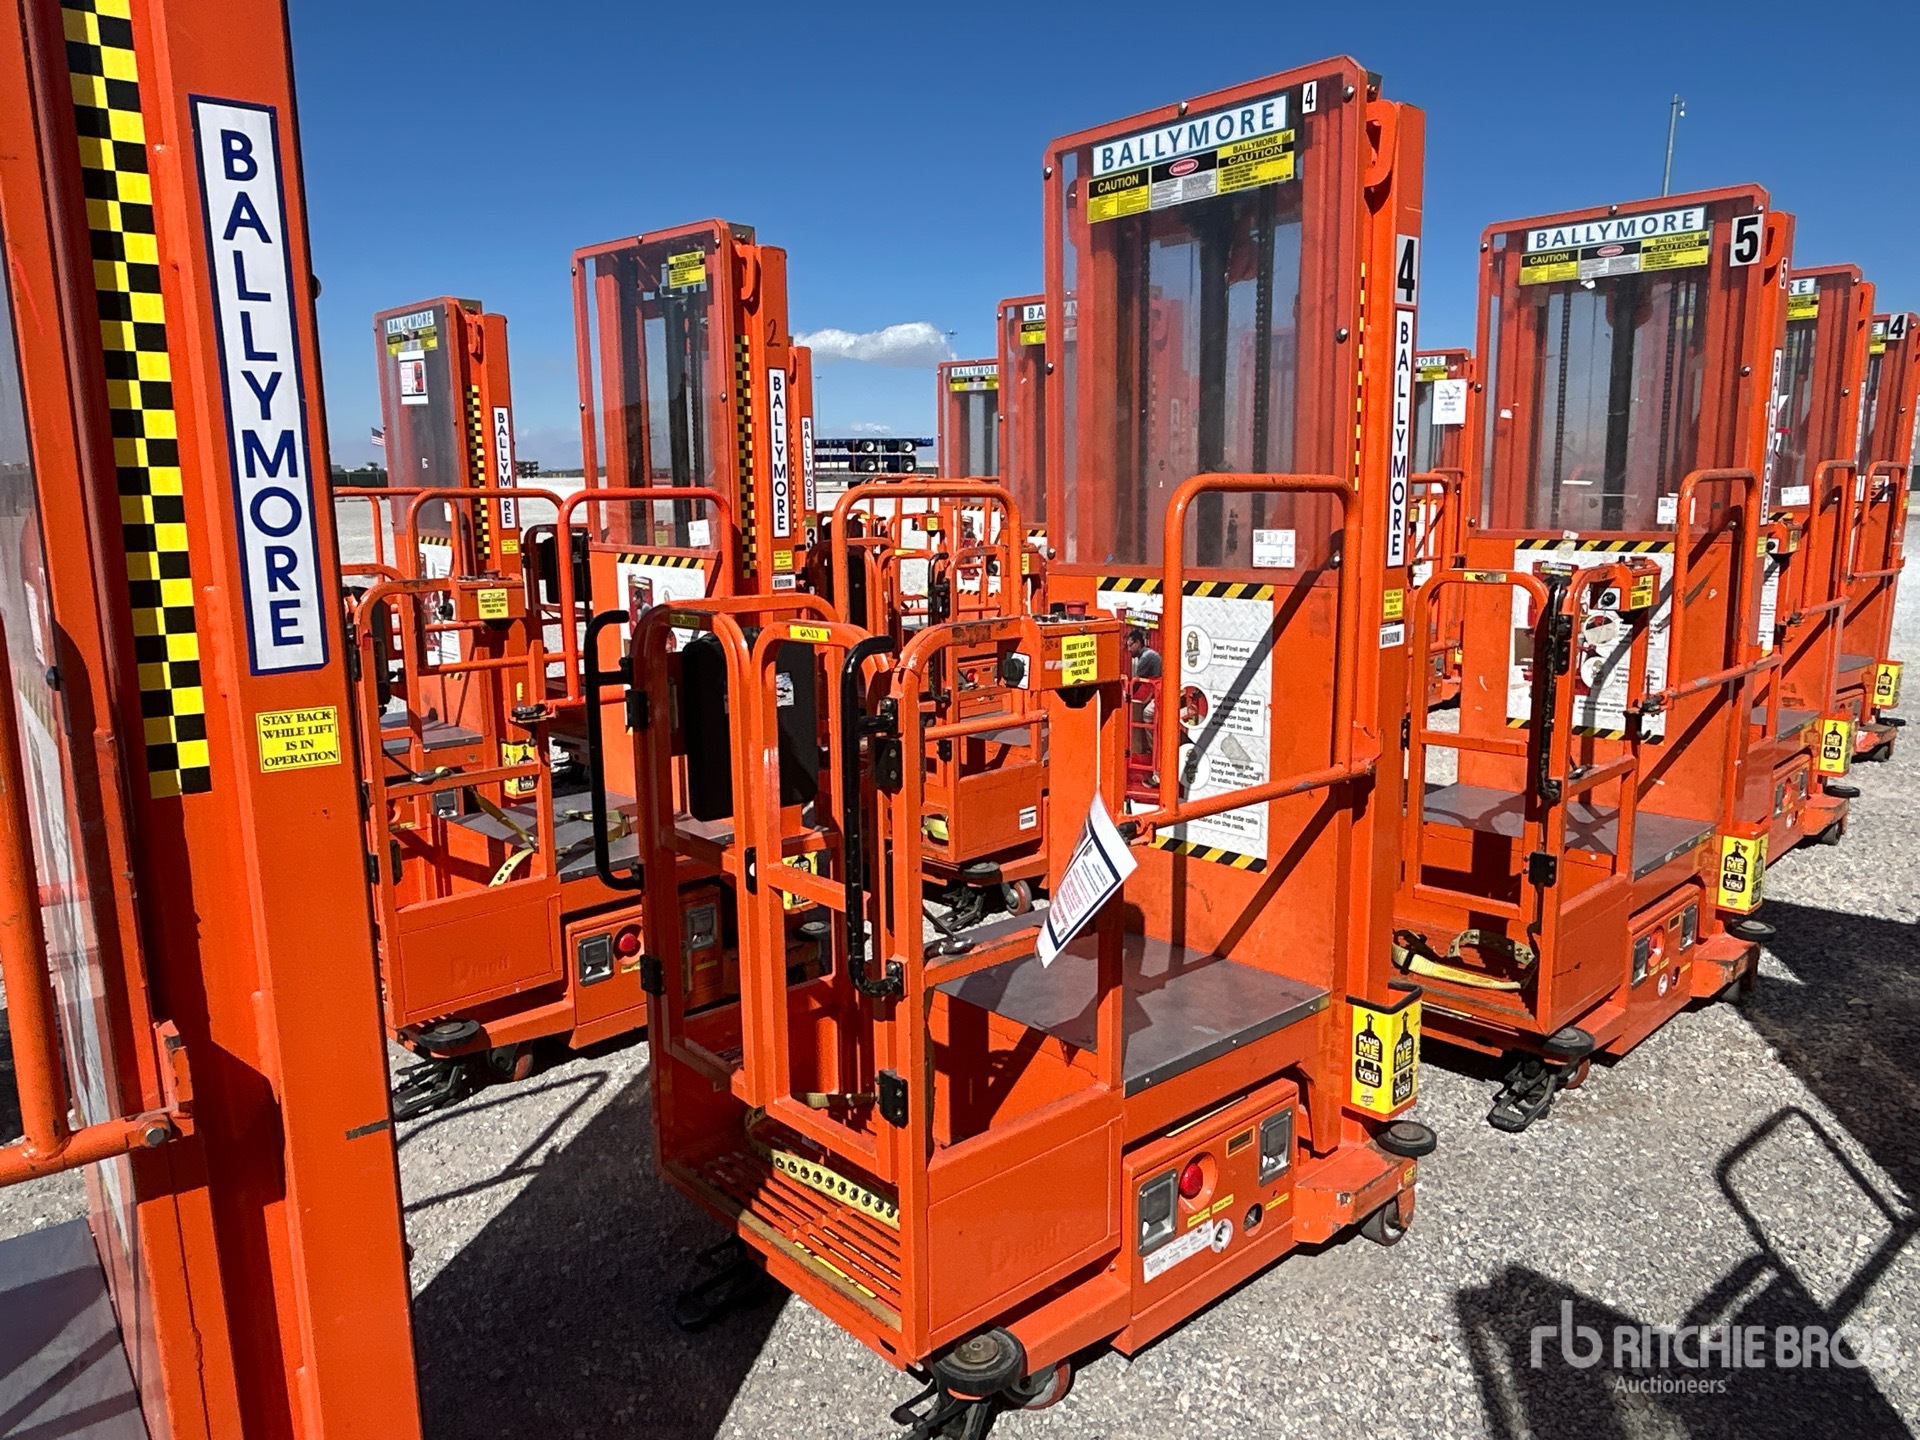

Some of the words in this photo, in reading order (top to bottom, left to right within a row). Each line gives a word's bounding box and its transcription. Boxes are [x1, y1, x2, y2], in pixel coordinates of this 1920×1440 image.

[1305, 83, 1314, 110] 4
[1101, 102, 1275, 171] BALLYMORE
[1232, 136, 1278, 154] BALLYMORE
[1227, 145, 1283, 165] CAUTION
[1097, 173, 1140, 193] CAUTION
[1535, 211, 1695, 249] BALLYMORE
[1734, 216, 1759, 264] 5
[1650, 240, 1700, 252] CAUTION
[1530, 253, 1569, 265] CAUTION
[1397, 239, 1415, 302] 4
[766, 318, 781, 348] 2
[1890, 314, 1905, 339] 4
[220, 128, 304, 646] BALLYMORE
[1391, 321, 1409, 556] BALLYMORE
[772, 376, 787, 531] BALLYMORE
[496, 412, 513, 525] BALLYMRE
[803, 421, 813, 508] BALLYMORE
[806, 528, 816, 550] 3
[262, 713, 294, 726] STAY
[296, 711, 332, 723] BACK
[262, 726, 306, 740] WHILE
[307, 723, 335, 735] LIFT
[285, 740, 298, 751] IS
[300, 739, 314, 750] IN
[264, 749, 337, 767] OPERATION
[1725, 880, 1743, 889] YOU
[1358, 1034, 1380, 1047] PLUG
[1358, 1042, 1380, 1056] ME
[1395, 1048, 1412, 1066] ME
[1358, 1071, 1379, 1084] YOU
[1394, 1081, 1411, 1098] YOU
